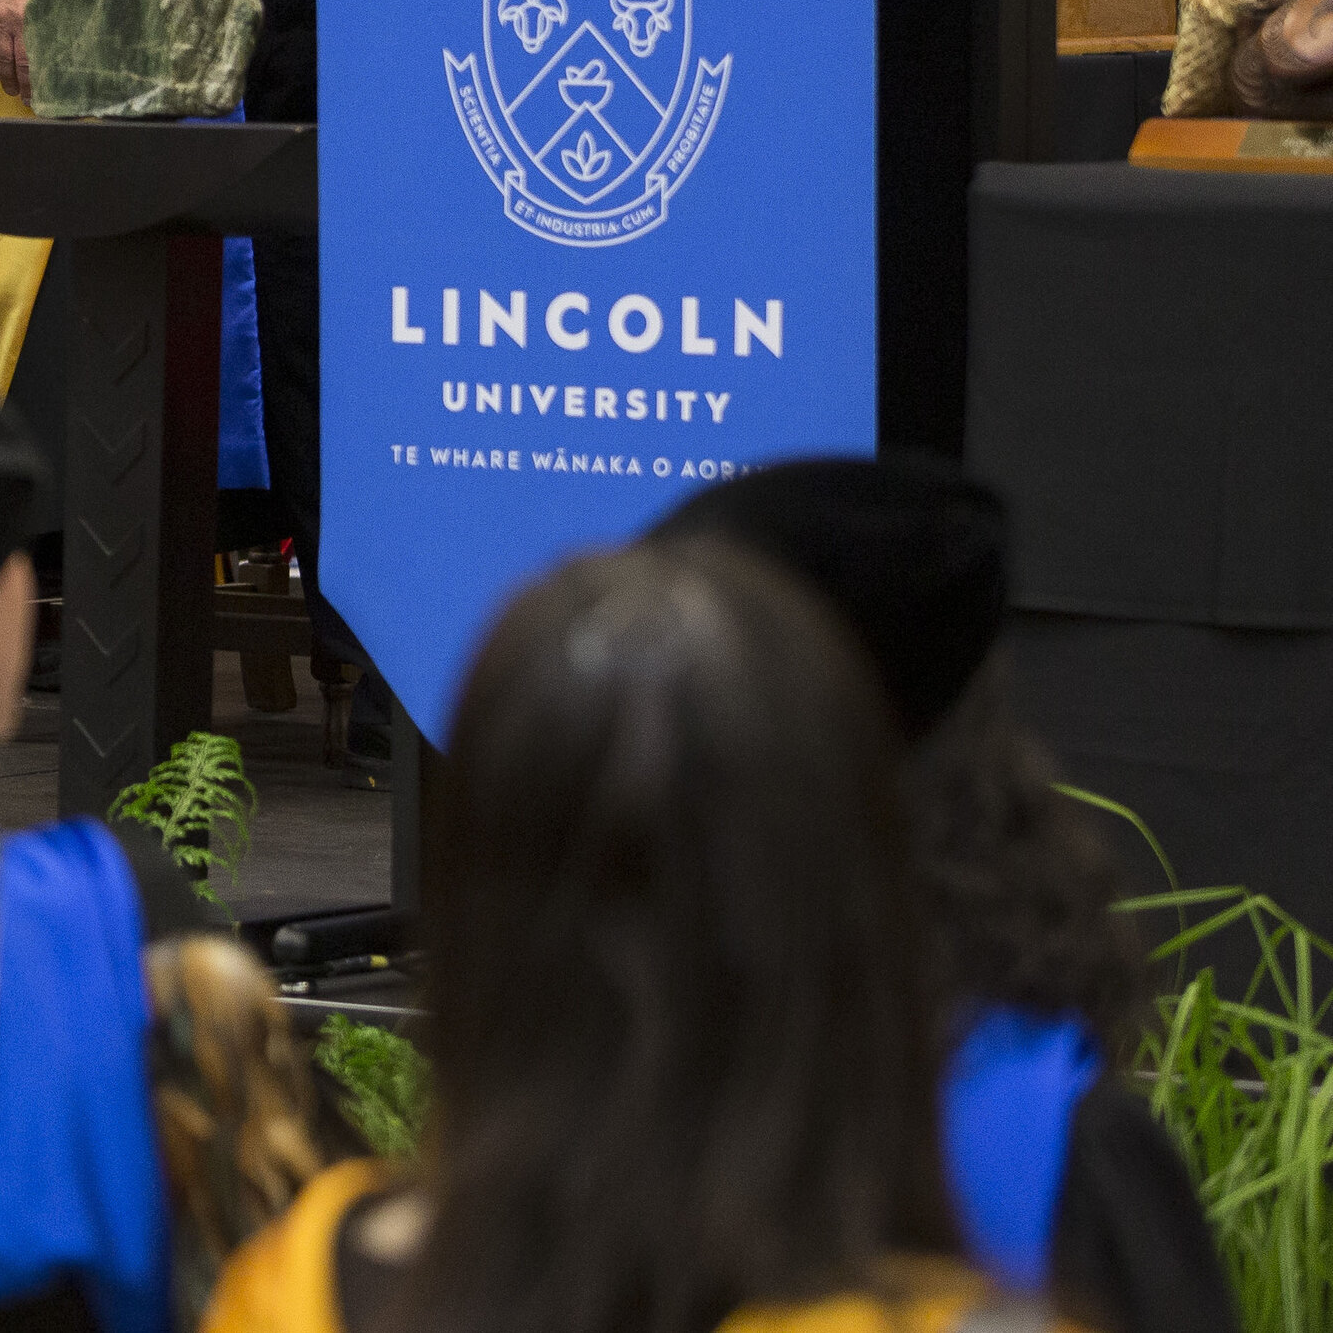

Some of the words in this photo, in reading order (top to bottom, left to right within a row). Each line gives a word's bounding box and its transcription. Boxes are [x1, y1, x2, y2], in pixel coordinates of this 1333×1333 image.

[458, 85, 502, 167] SCIENTIA
[666, 83, 717, 173] PROBITATE
[391, 285, 784, 359] LINCOLN
[441, 380, 732, 423] UNIVERSITY
[390, 444, 419, 466] TE
[430, 446, 521, 470] WHARE
[532, 447, 641, 477] WĀNAKA
[652, 457, 673, 478] O
[680, 457, 772, 481] AOR
